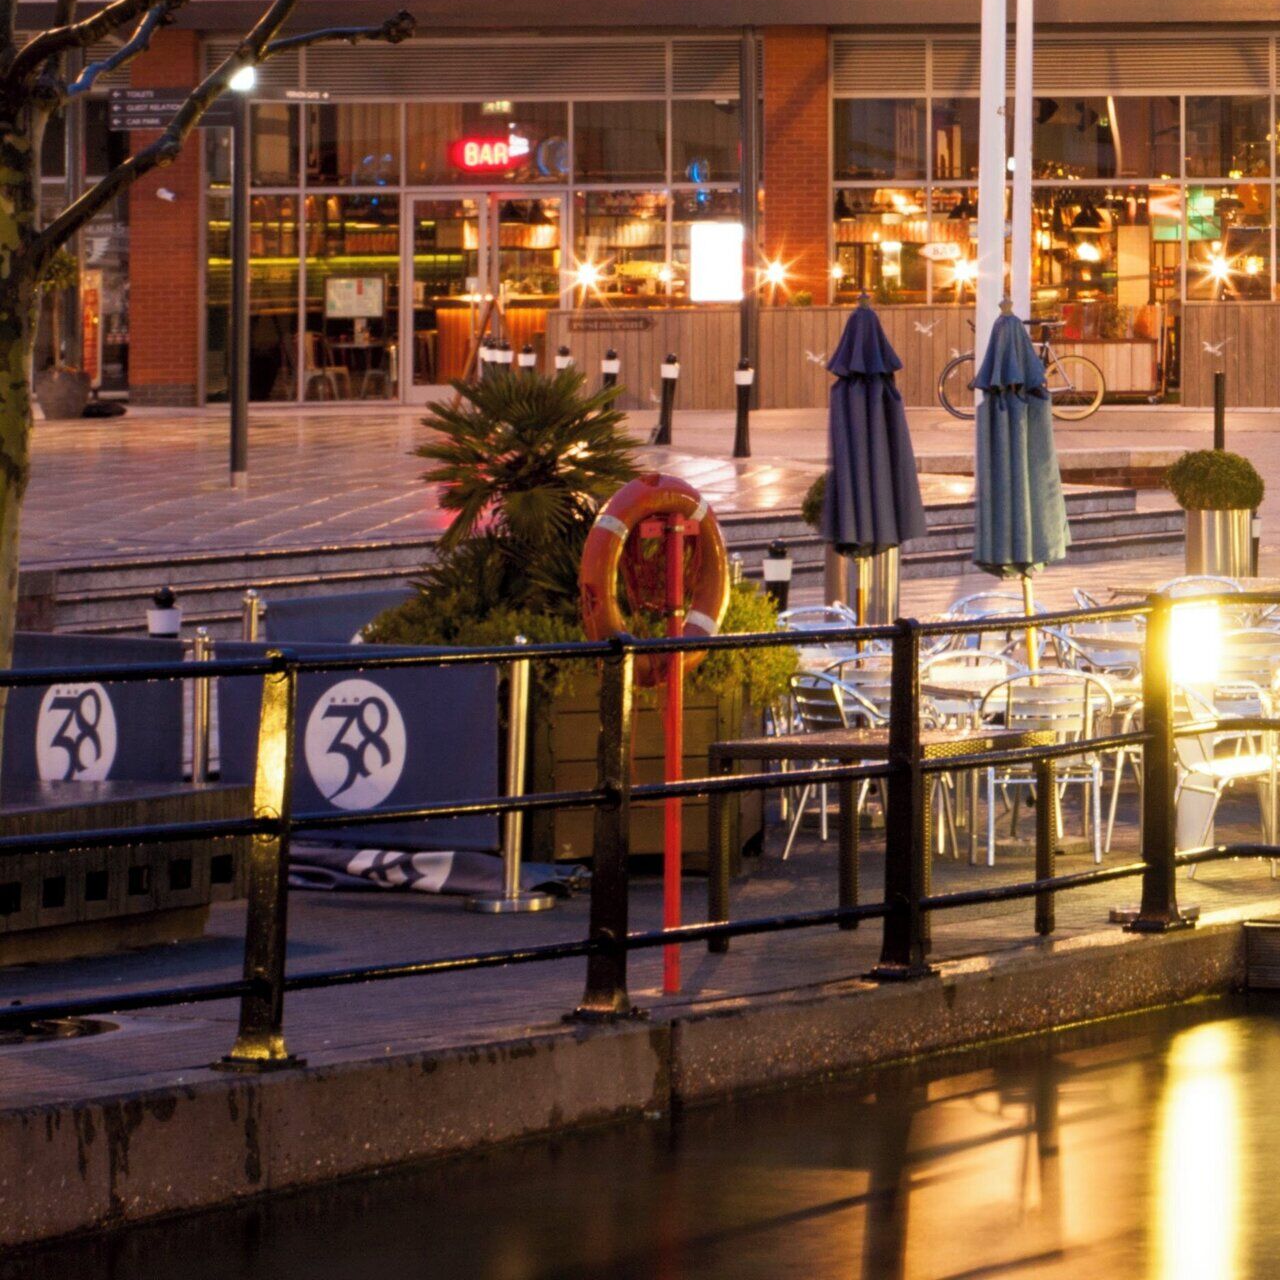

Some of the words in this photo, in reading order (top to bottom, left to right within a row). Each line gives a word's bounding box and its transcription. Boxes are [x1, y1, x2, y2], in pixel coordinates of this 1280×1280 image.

[126, 103, 148, 112] GUEST
[149, 103, 182, 112] RELATION
[464, 141, 509, 167] BAR
[572, 320, 645, 330] restaurant
[48, 688, 102, 781] 38
[321, 696, 392, 801] 38
